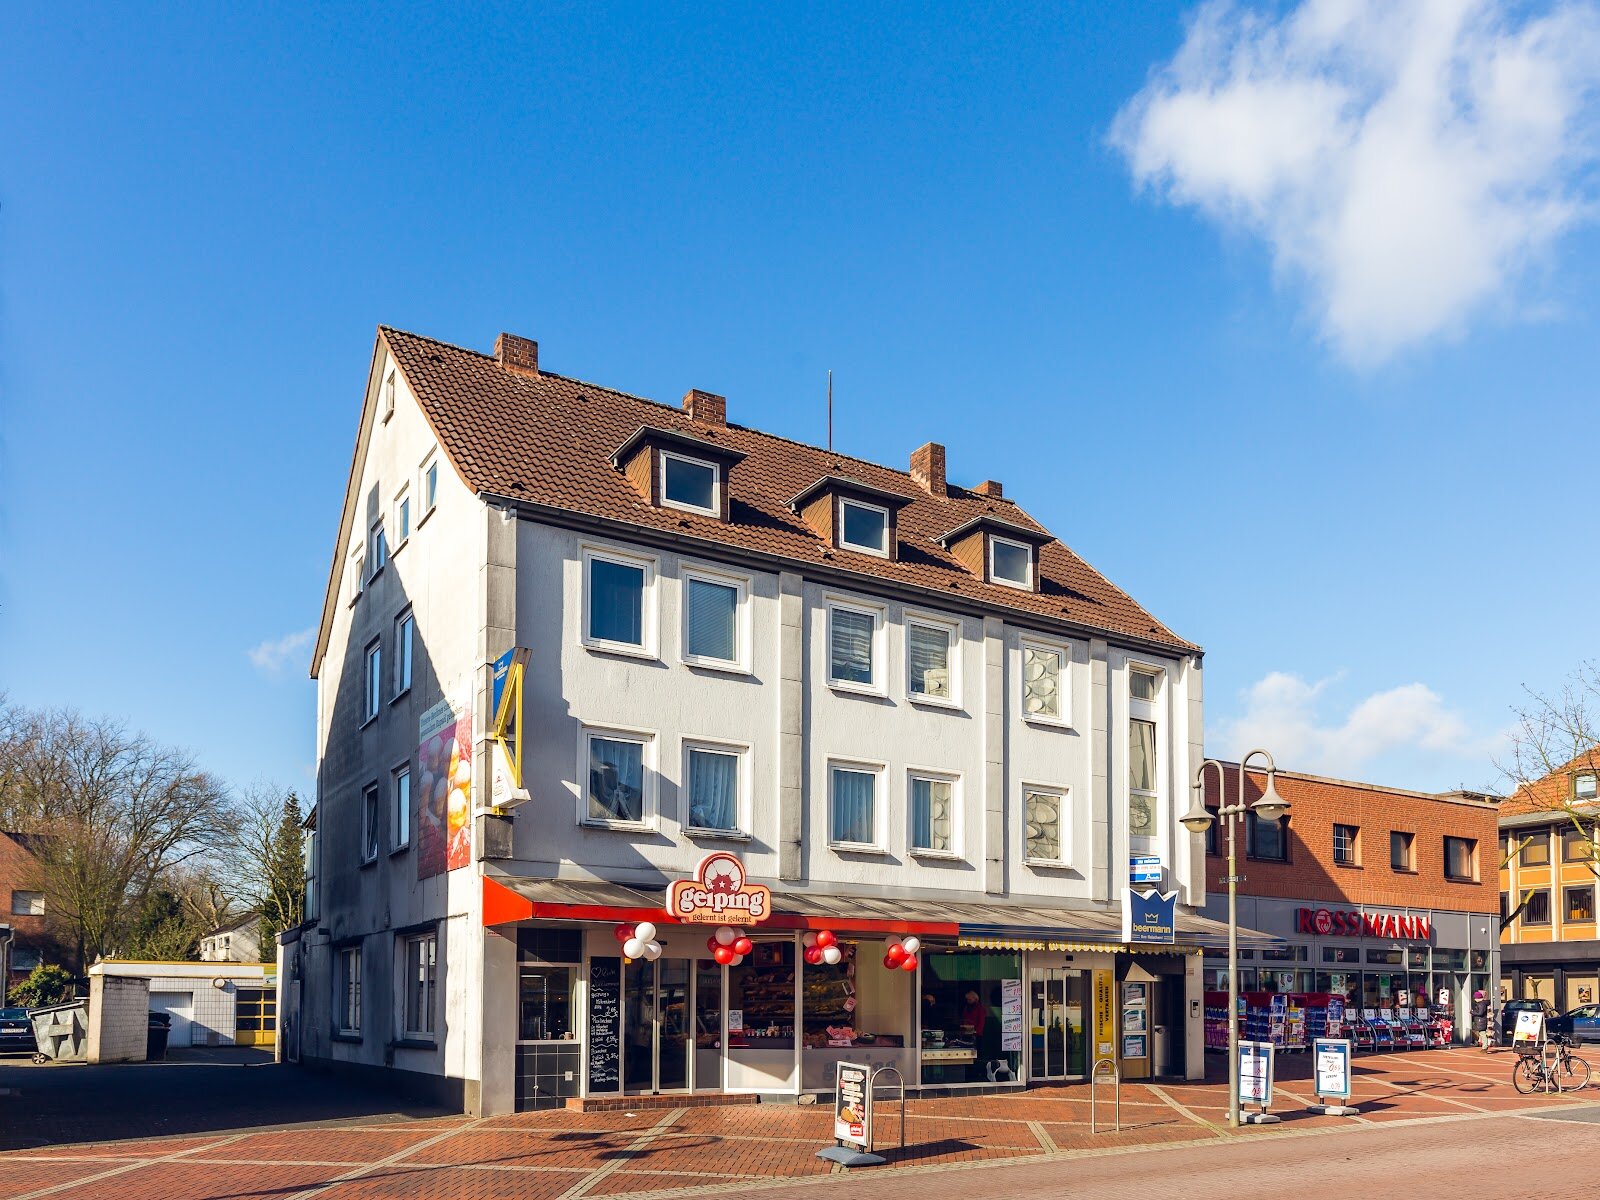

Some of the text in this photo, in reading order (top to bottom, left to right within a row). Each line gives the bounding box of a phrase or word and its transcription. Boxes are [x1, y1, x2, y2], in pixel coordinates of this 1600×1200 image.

[680, 887, 764, 916] geiping
[692, 912, 752, 923] gelernt ist gelernt
[1296, 907, 1429, 940] ROSSMANN
[1133, 922, 1171, 934] beermann
